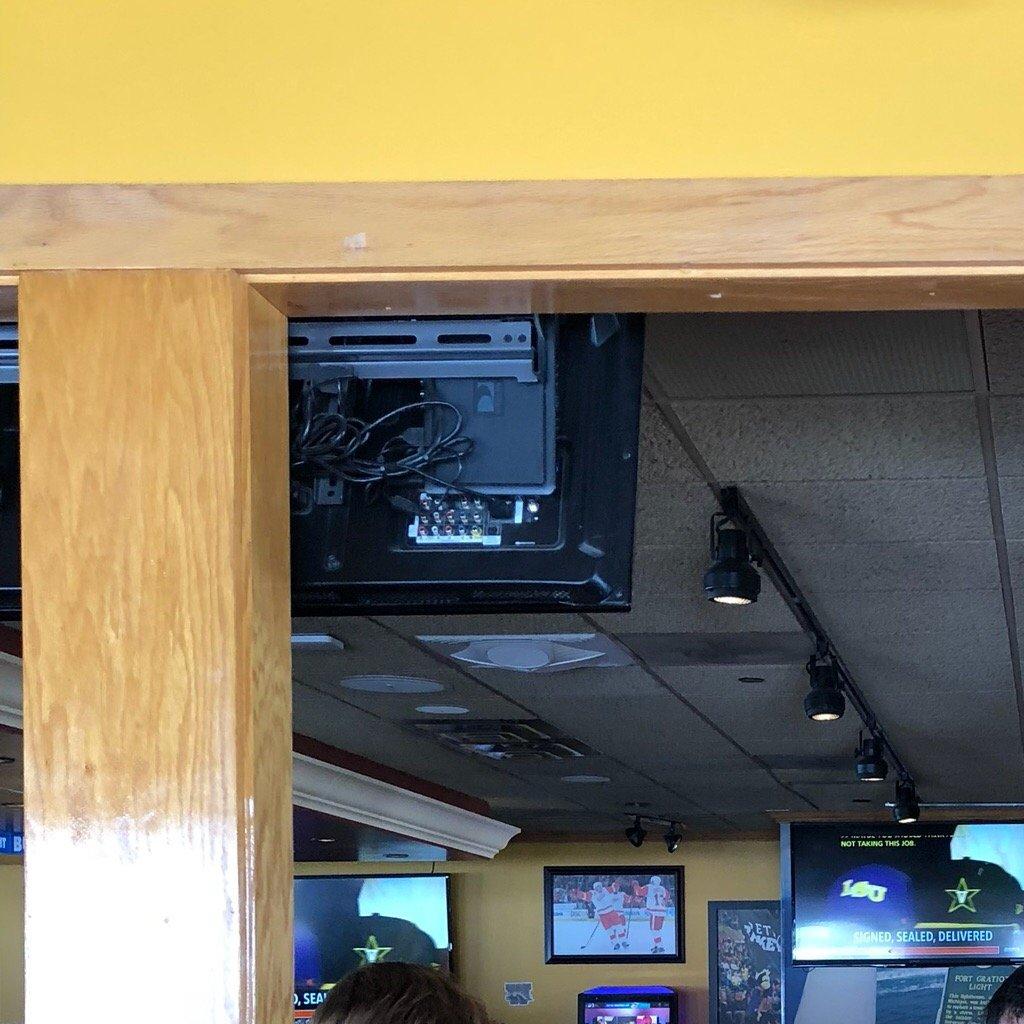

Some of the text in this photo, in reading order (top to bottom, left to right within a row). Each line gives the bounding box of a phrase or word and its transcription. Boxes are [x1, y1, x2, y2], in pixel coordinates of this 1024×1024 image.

[840, 879, 887, 903] LSU
[853, 930, 993, 944] SIGNED, SEALED, DELIVERED
[968, 983, 993, 991] LIGHT
